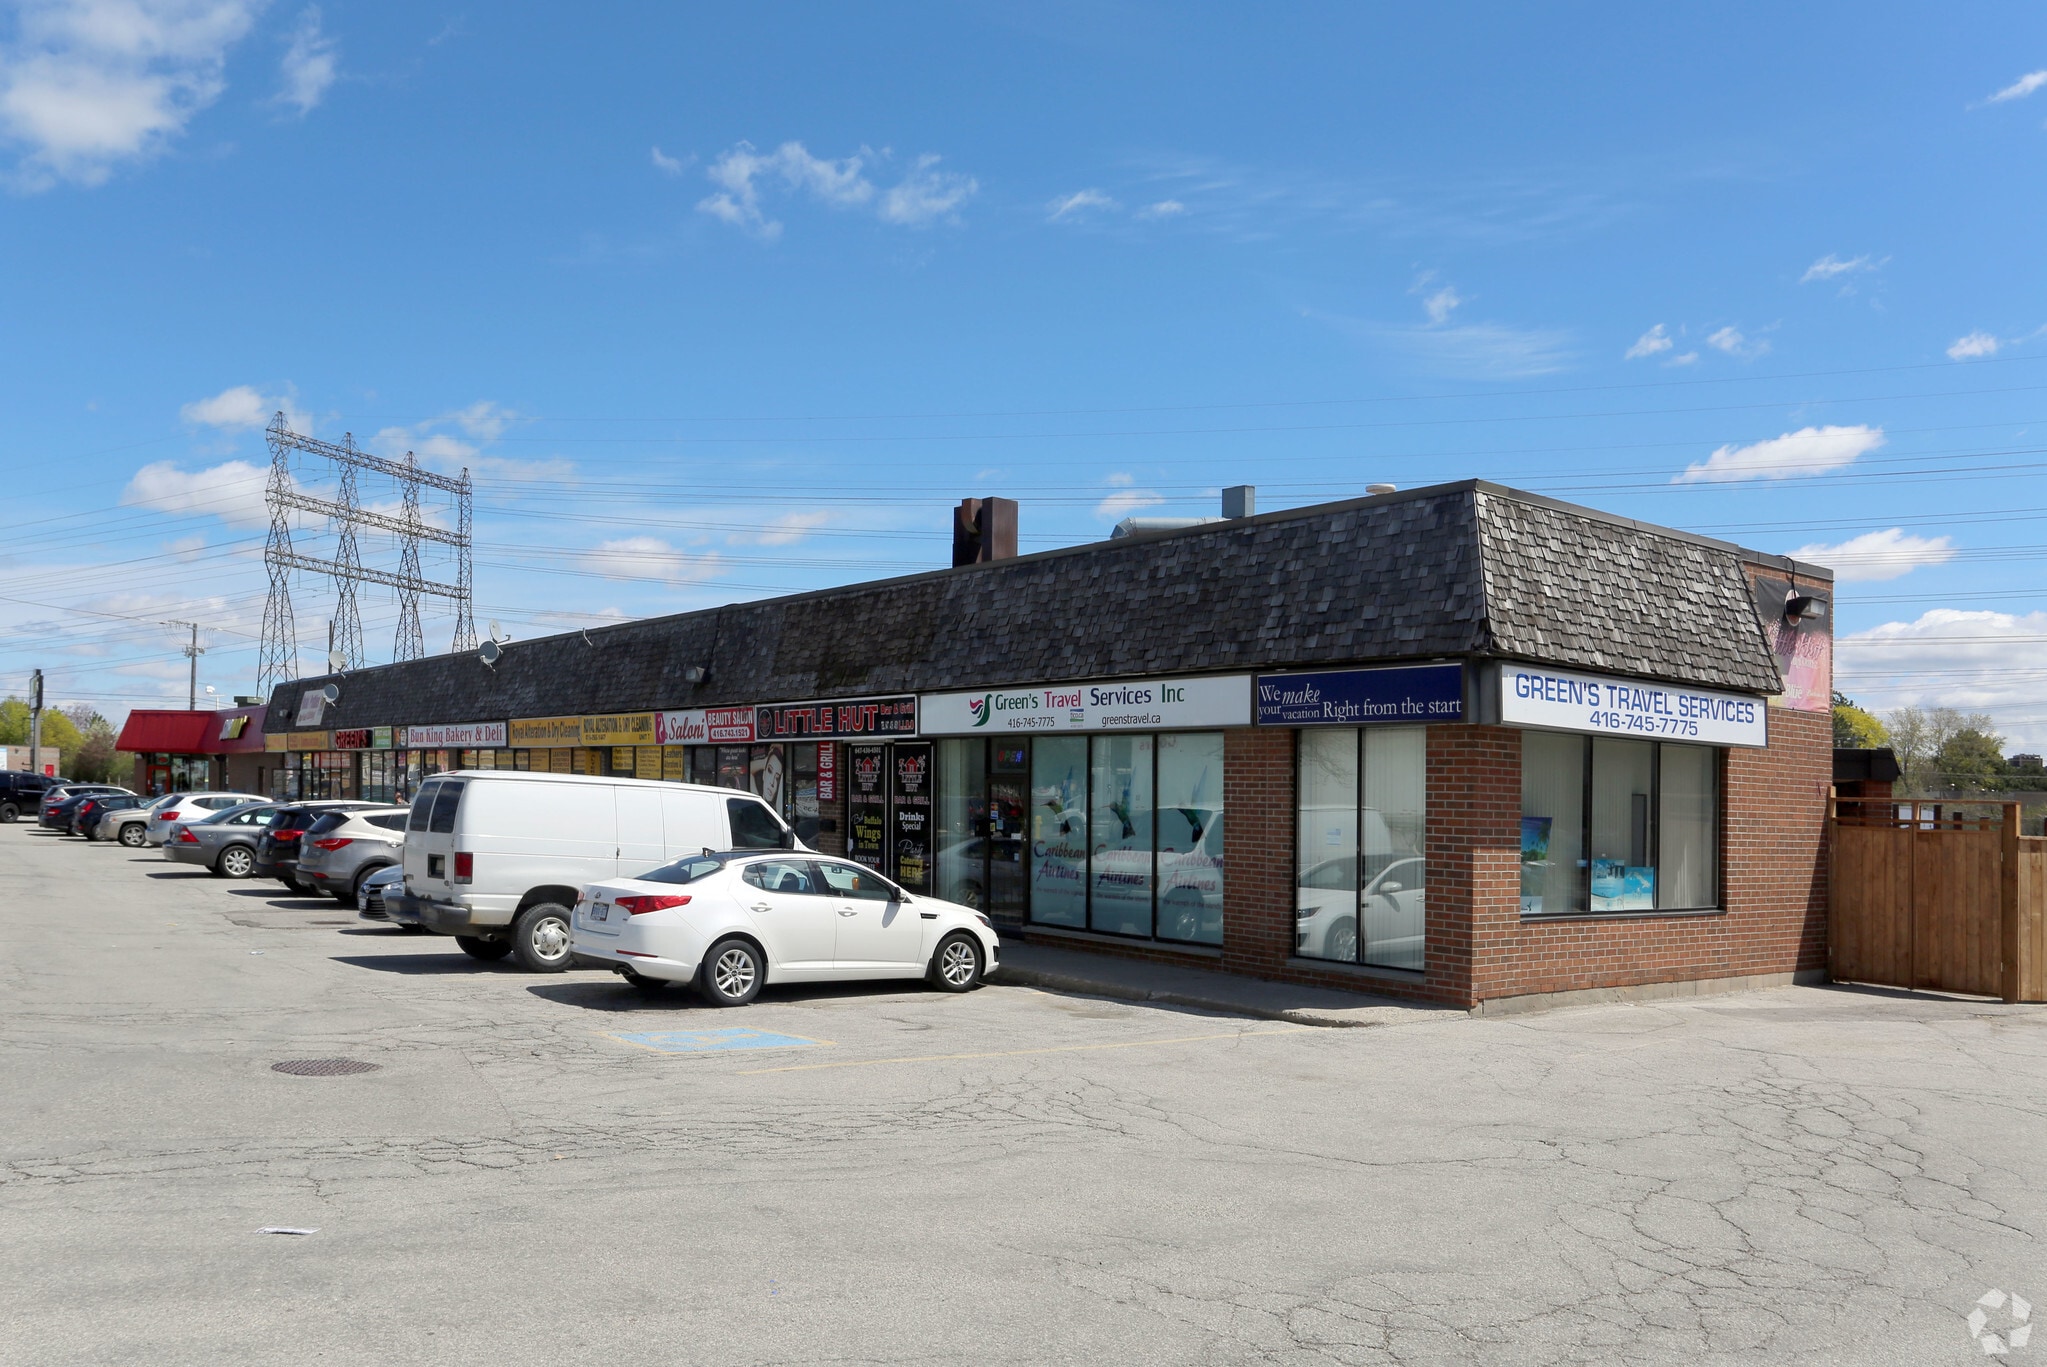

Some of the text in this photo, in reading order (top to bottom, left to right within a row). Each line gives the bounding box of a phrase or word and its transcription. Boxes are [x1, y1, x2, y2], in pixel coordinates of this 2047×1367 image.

[995, 684, 1185, 710] Green's Travel Services Inc
[1260, 683, 1320, 704] We make
[1515, 673, 1754, 724] GREEN'S TRAVEL SERVICES
[708, 710, 753, 726] BEAUTY SALON
[774, 704, 878, 734] LITTLE HUT
[1259, 697, 1461, 723] your vacation Right from the start
[631, 715, 652, 732] CLEANING
[669, 717, 705, 740] Saloni
[1008, 717, 1055, 728] 416-745-7775
[1102, 713, 1161, 727] greenstravel.ca
[1589, 710, 1698, 736] 416-745-7775
[335, 730, 367, 748] GREEN'S
[410, 729, 424, 743] Bun
[426, 728, 443, 747] King
[445, 727, 472, 746] Bakery
[475, 727, 482, 741] &
[485, 724, 502, 741] Deli
[512, 724, 524, 743] Royal
[525, 722, 546, 739] Alteration
[820, 743, 833, 769] GRILL
[901, 774, 922, 783] LITTLE
[905, 784, 918, 792] HUT
[820, 780, 833, 799] BAR
[894, 796, 906, 804] BAR
[912, 796, 930, 805] GRILL
[899, 812, 924, 821] Drinks
[856, 825, 881, 842] Wings
[902, 822, 921, 832] Special
[864, 841, 879, 850] Town
[898, 839, 924, 858] Party
[1034, 840, 1086, 859] Caribbean
[1095, 844, 1152, 864] Caribbean
[900, 856, 924, 867] Catering
[1161, 847, 1223, 868] Caribbean
[900, 865, 923, 878] HERE
[1036, 859, 1079, 882] Airlines
[1097, 864, 1144, 887] Airlines
[1164, 870, 1216, 893] Airlines
